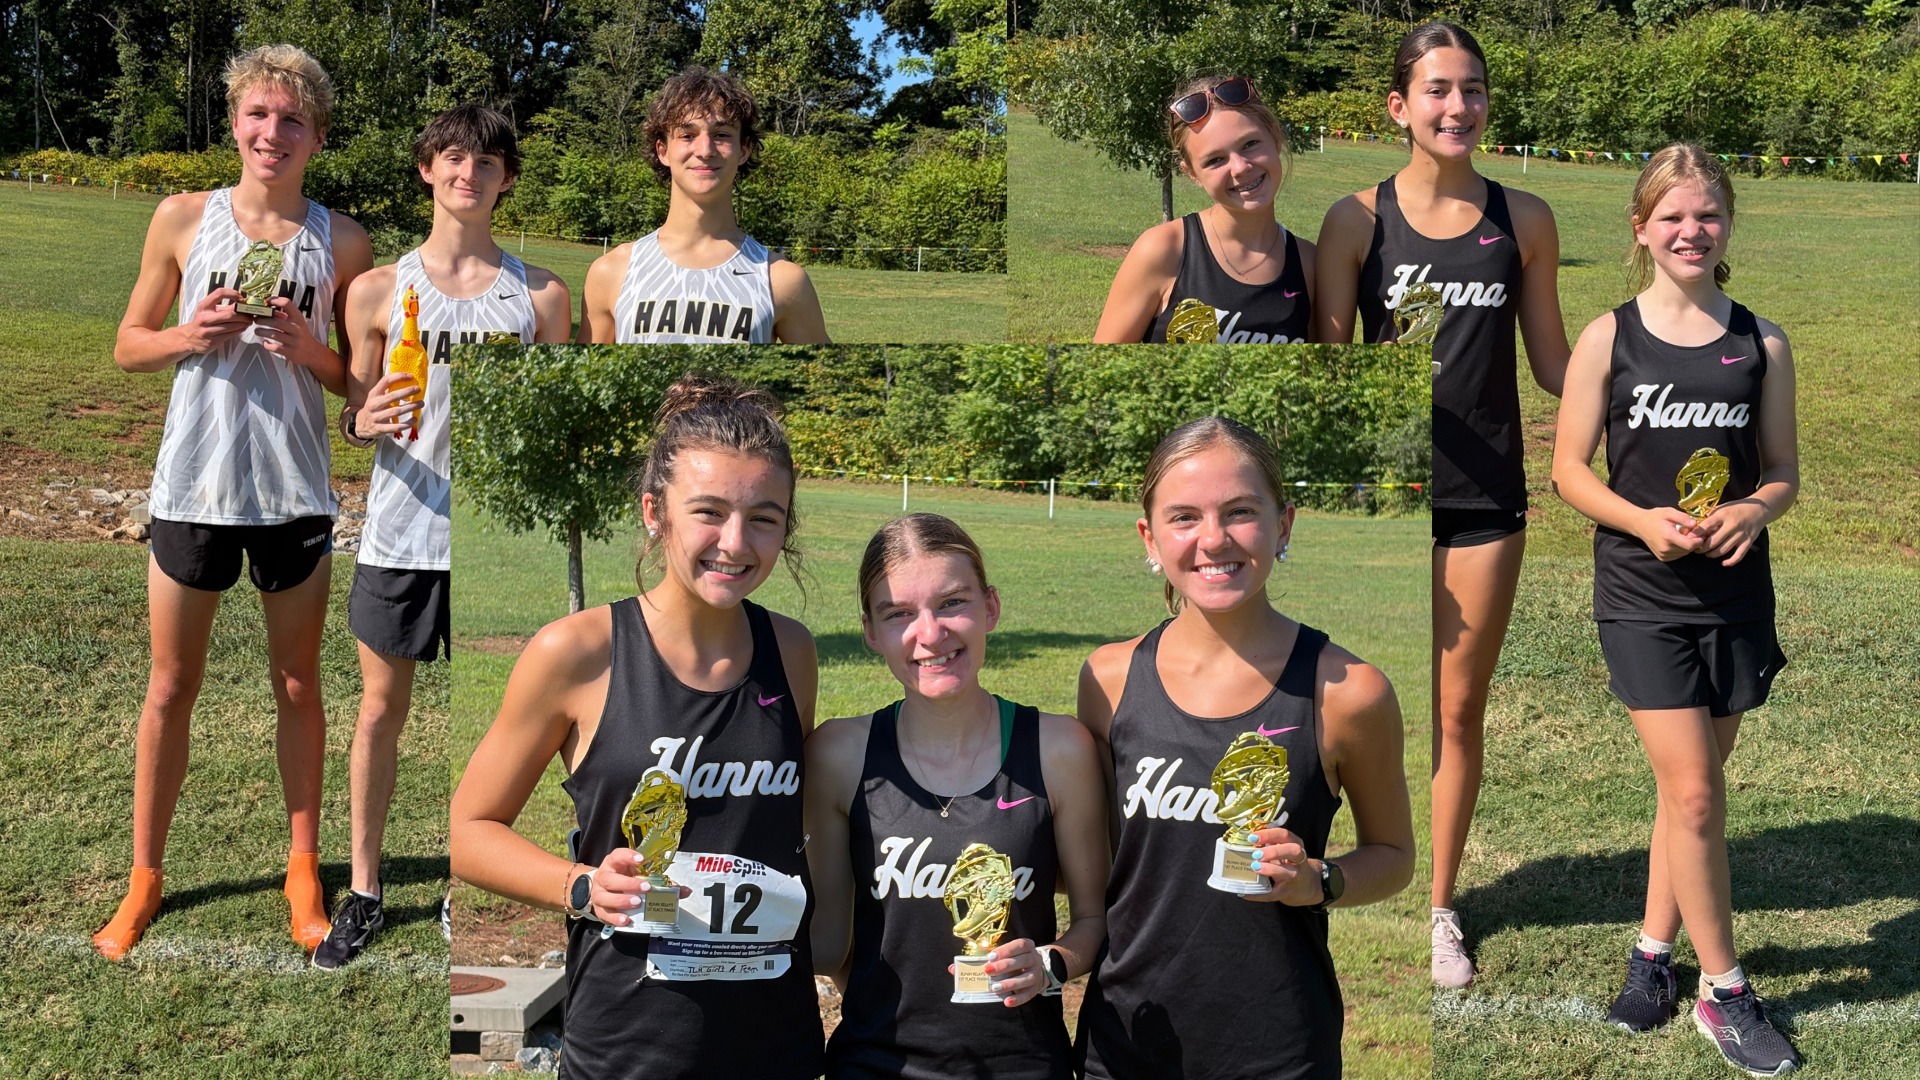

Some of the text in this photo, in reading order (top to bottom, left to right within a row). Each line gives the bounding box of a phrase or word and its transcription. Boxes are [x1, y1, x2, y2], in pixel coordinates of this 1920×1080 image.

[207, 271, 316, 319] HANA
[634, 299, 753, 342] HANNA
[1628, 383, 1749, 429] Hanna
[695, 856, 767, 877] MileSplit
[871, 837, 1036, 901] Haa
[703, 882, 763, 934] 12
[729, 965, 737, 973] A
